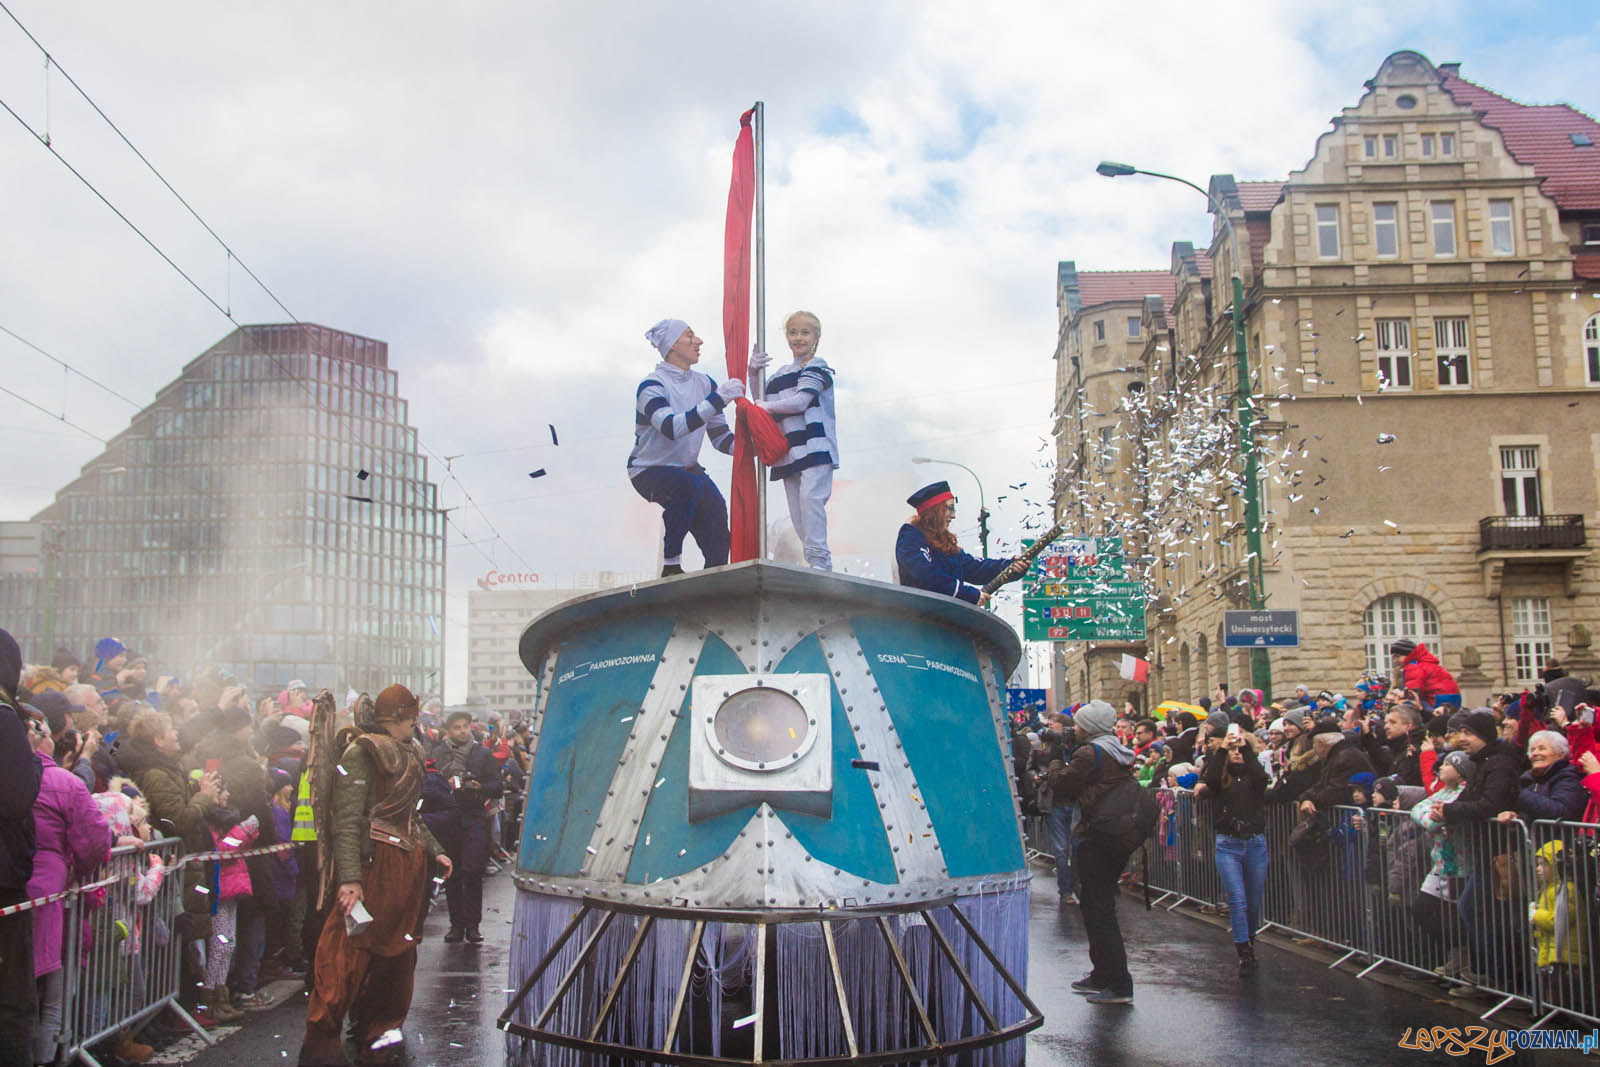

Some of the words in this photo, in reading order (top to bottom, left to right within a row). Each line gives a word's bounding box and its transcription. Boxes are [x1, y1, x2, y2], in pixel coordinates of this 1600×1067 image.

[486, 570, 540, 585] Centra
[1079, 608, 1087, 618] 11
[1250, 614, 1273, 622] most
[1231, 624, 1293, 634] Uniwersytecki
[589, 654, 656, 672] PAROWOZOWNIA
[877, 654, 907, 665] SCENA
[925, 659, 979, 684] PAROWOZOWNIA
